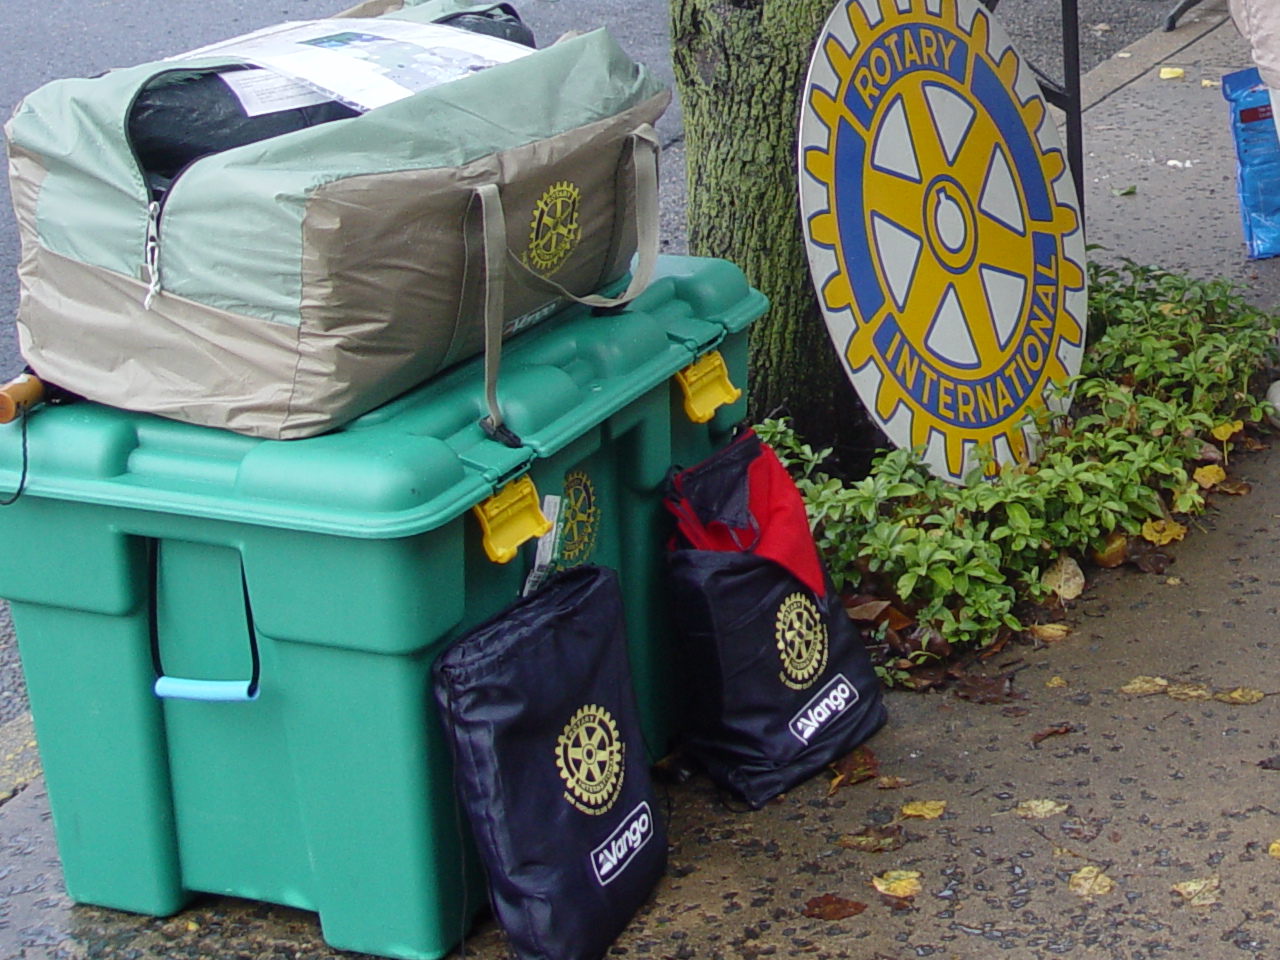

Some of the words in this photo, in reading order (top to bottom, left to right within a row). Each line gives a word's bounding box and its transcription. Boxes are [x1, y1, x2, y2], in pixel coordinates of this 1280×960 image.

[854, 27, 957, 111] ROTARY
[884, 252, 1058, 425] INTERNATIONAL
[801, 683, 850, 729] Vango
[602, 812, 650, 866] Vango
